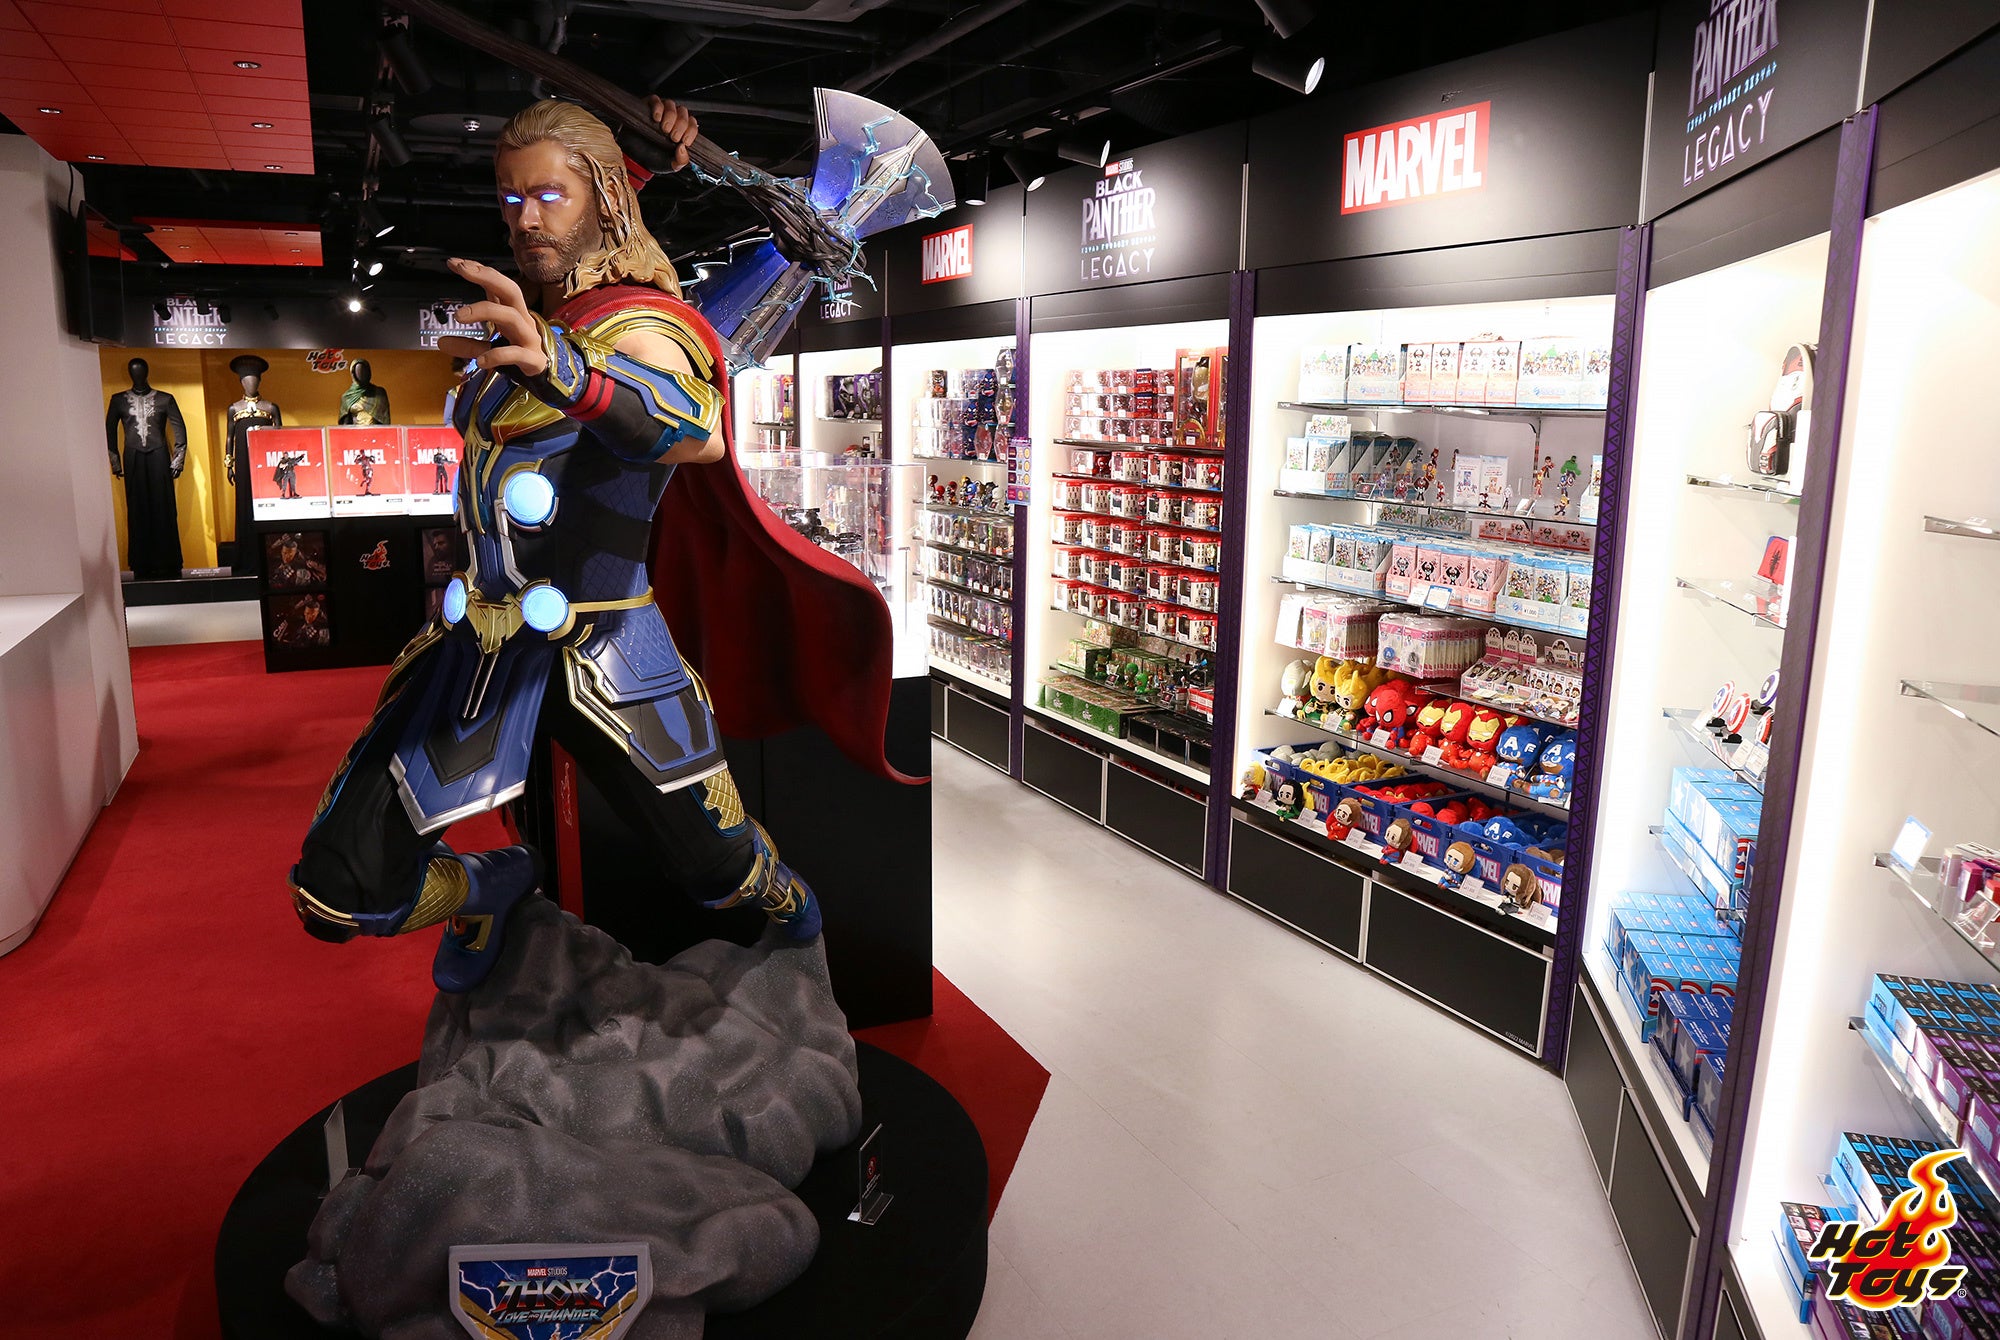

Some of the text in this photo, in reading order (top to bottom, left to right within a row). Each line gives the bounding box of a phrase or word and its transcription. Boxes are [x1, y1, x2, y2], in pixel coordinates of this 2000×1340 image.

[1683, 87, 1775, 187] LEGACY
[1344, 111, 1482, 208] MARVEL
[1095, 170, 1143, 198] BLACK
[1081, 187, 1156, 245] PANTHER
[923, 229, 971, 281] MARVEL
[1081, 248, 1155, 280] LEGACY
[155, 333, 227, 344] LEGACY
[527, 1267, 568, 1277] MARVEL STUDIOS
[493, 1279, 606, 1313] THOR
[496, 1310, 530, 1324] LOVE
[531, 1308, 603, 1322] THUNDER
